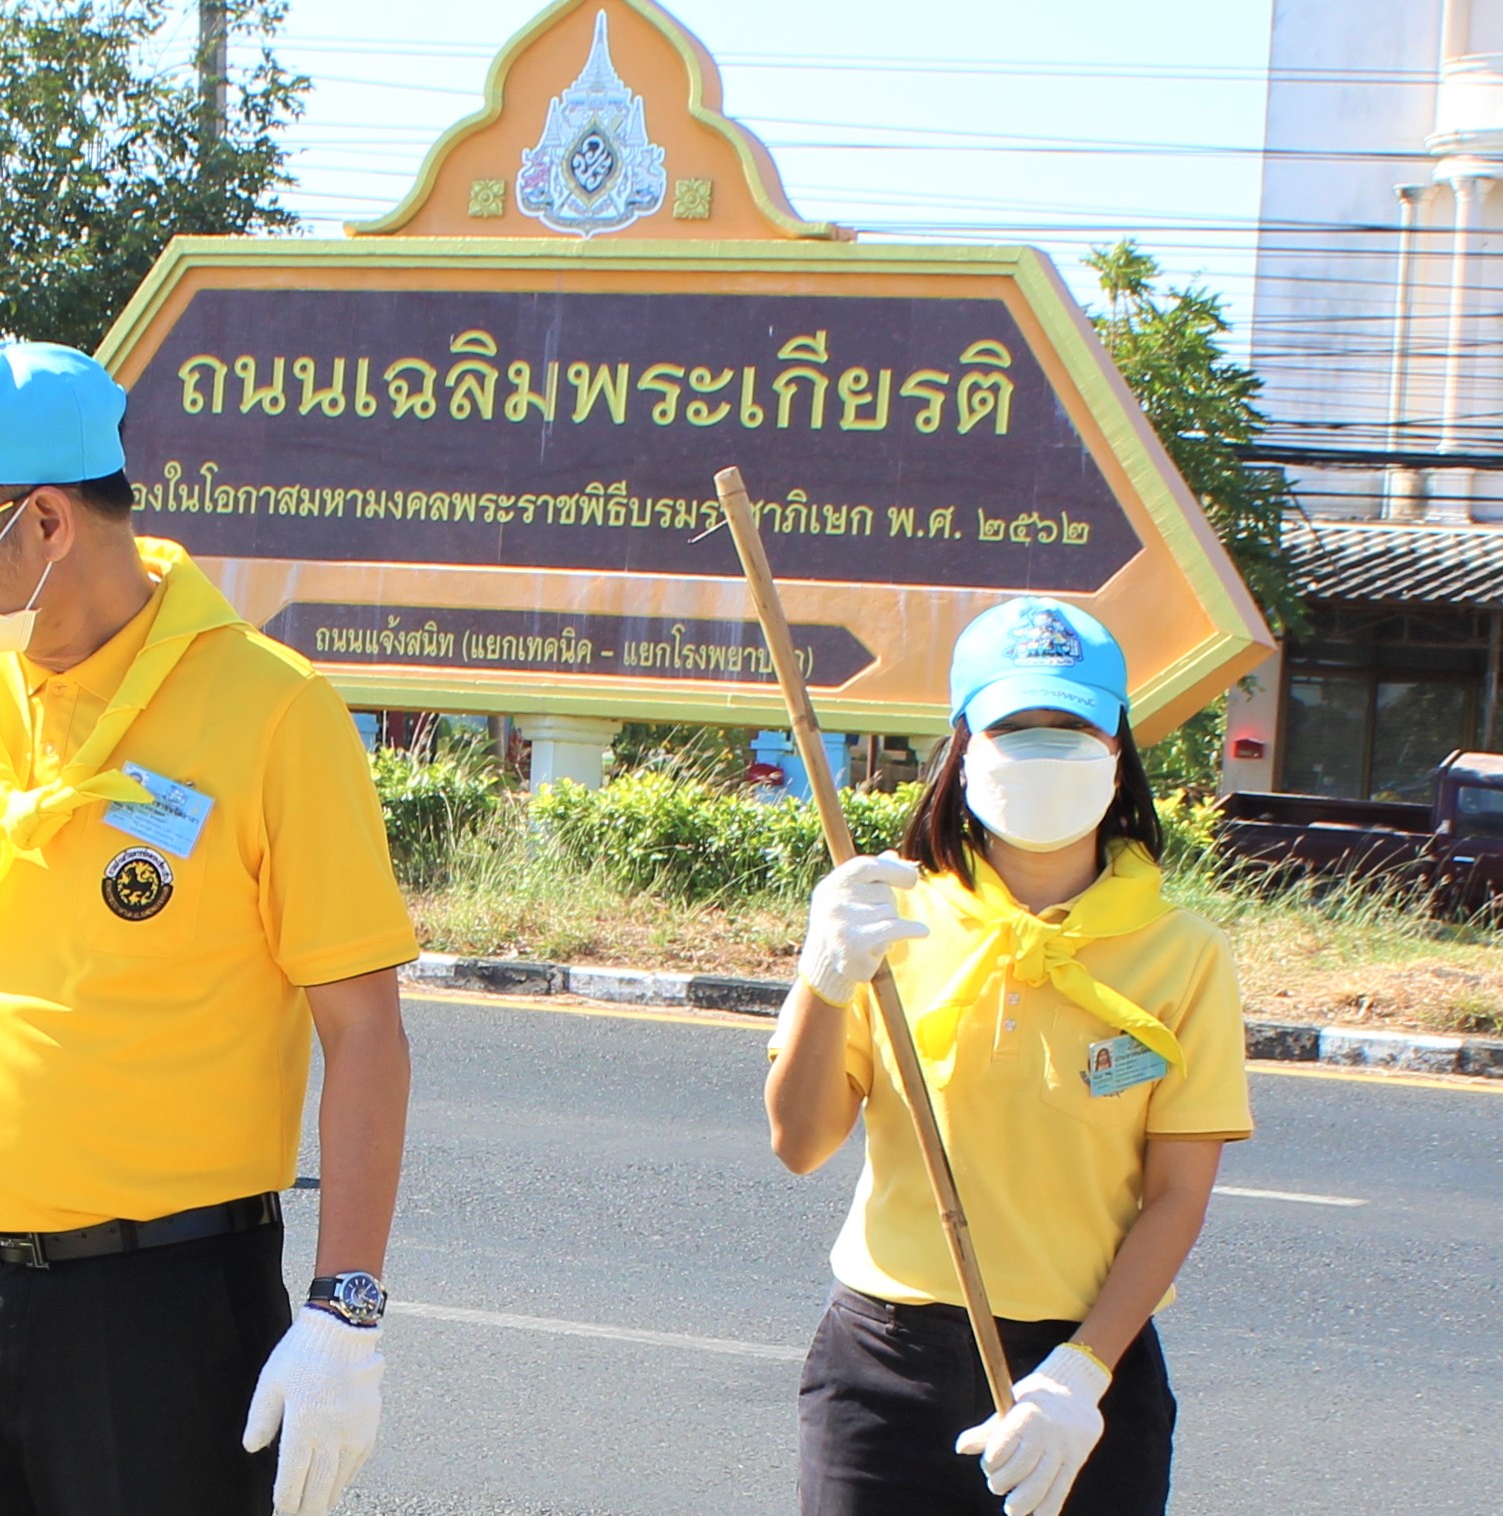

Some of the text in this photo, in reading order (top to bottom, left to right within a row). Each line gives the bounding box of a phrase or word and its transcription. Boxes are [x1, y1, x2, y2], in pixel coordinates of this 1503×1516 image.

[177, 328, 1015, 437] ถนนเฉลิมพระเกียรติ
[887, 504, 962, 540] พ.ศ.
[977, 506, 1091, 547] ๒๕๖๒
[314, 615, 454, 660] ถนนแจ้งสนิท
[461, 627, 593, 666] (แยกเทคนิค
[623, 624, 814, 680] แยกโรงพยาบ)
